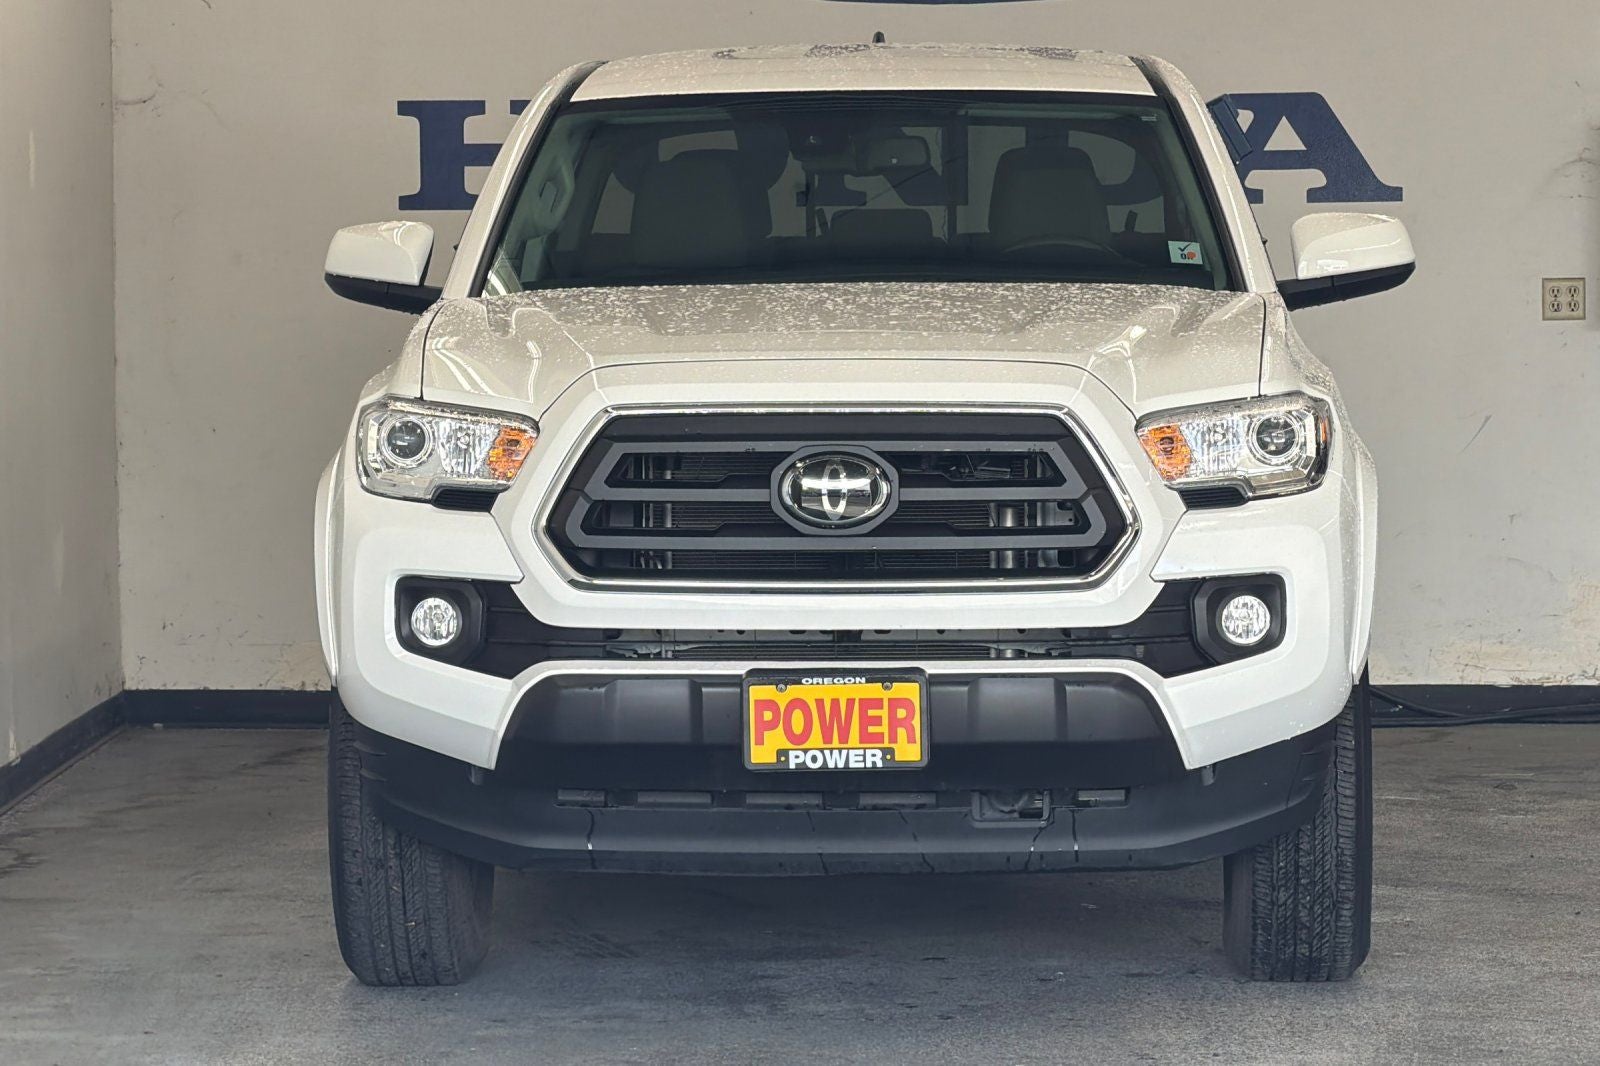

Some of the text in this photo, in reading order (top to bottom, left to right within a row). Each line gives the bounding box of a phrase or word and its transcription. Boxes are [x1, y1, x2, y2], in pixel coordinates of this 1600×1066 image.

[801, 677, 866, 685] OREGON
[754, 697, 917, 746] POWER
[788, 749, 883, 769] POWER
